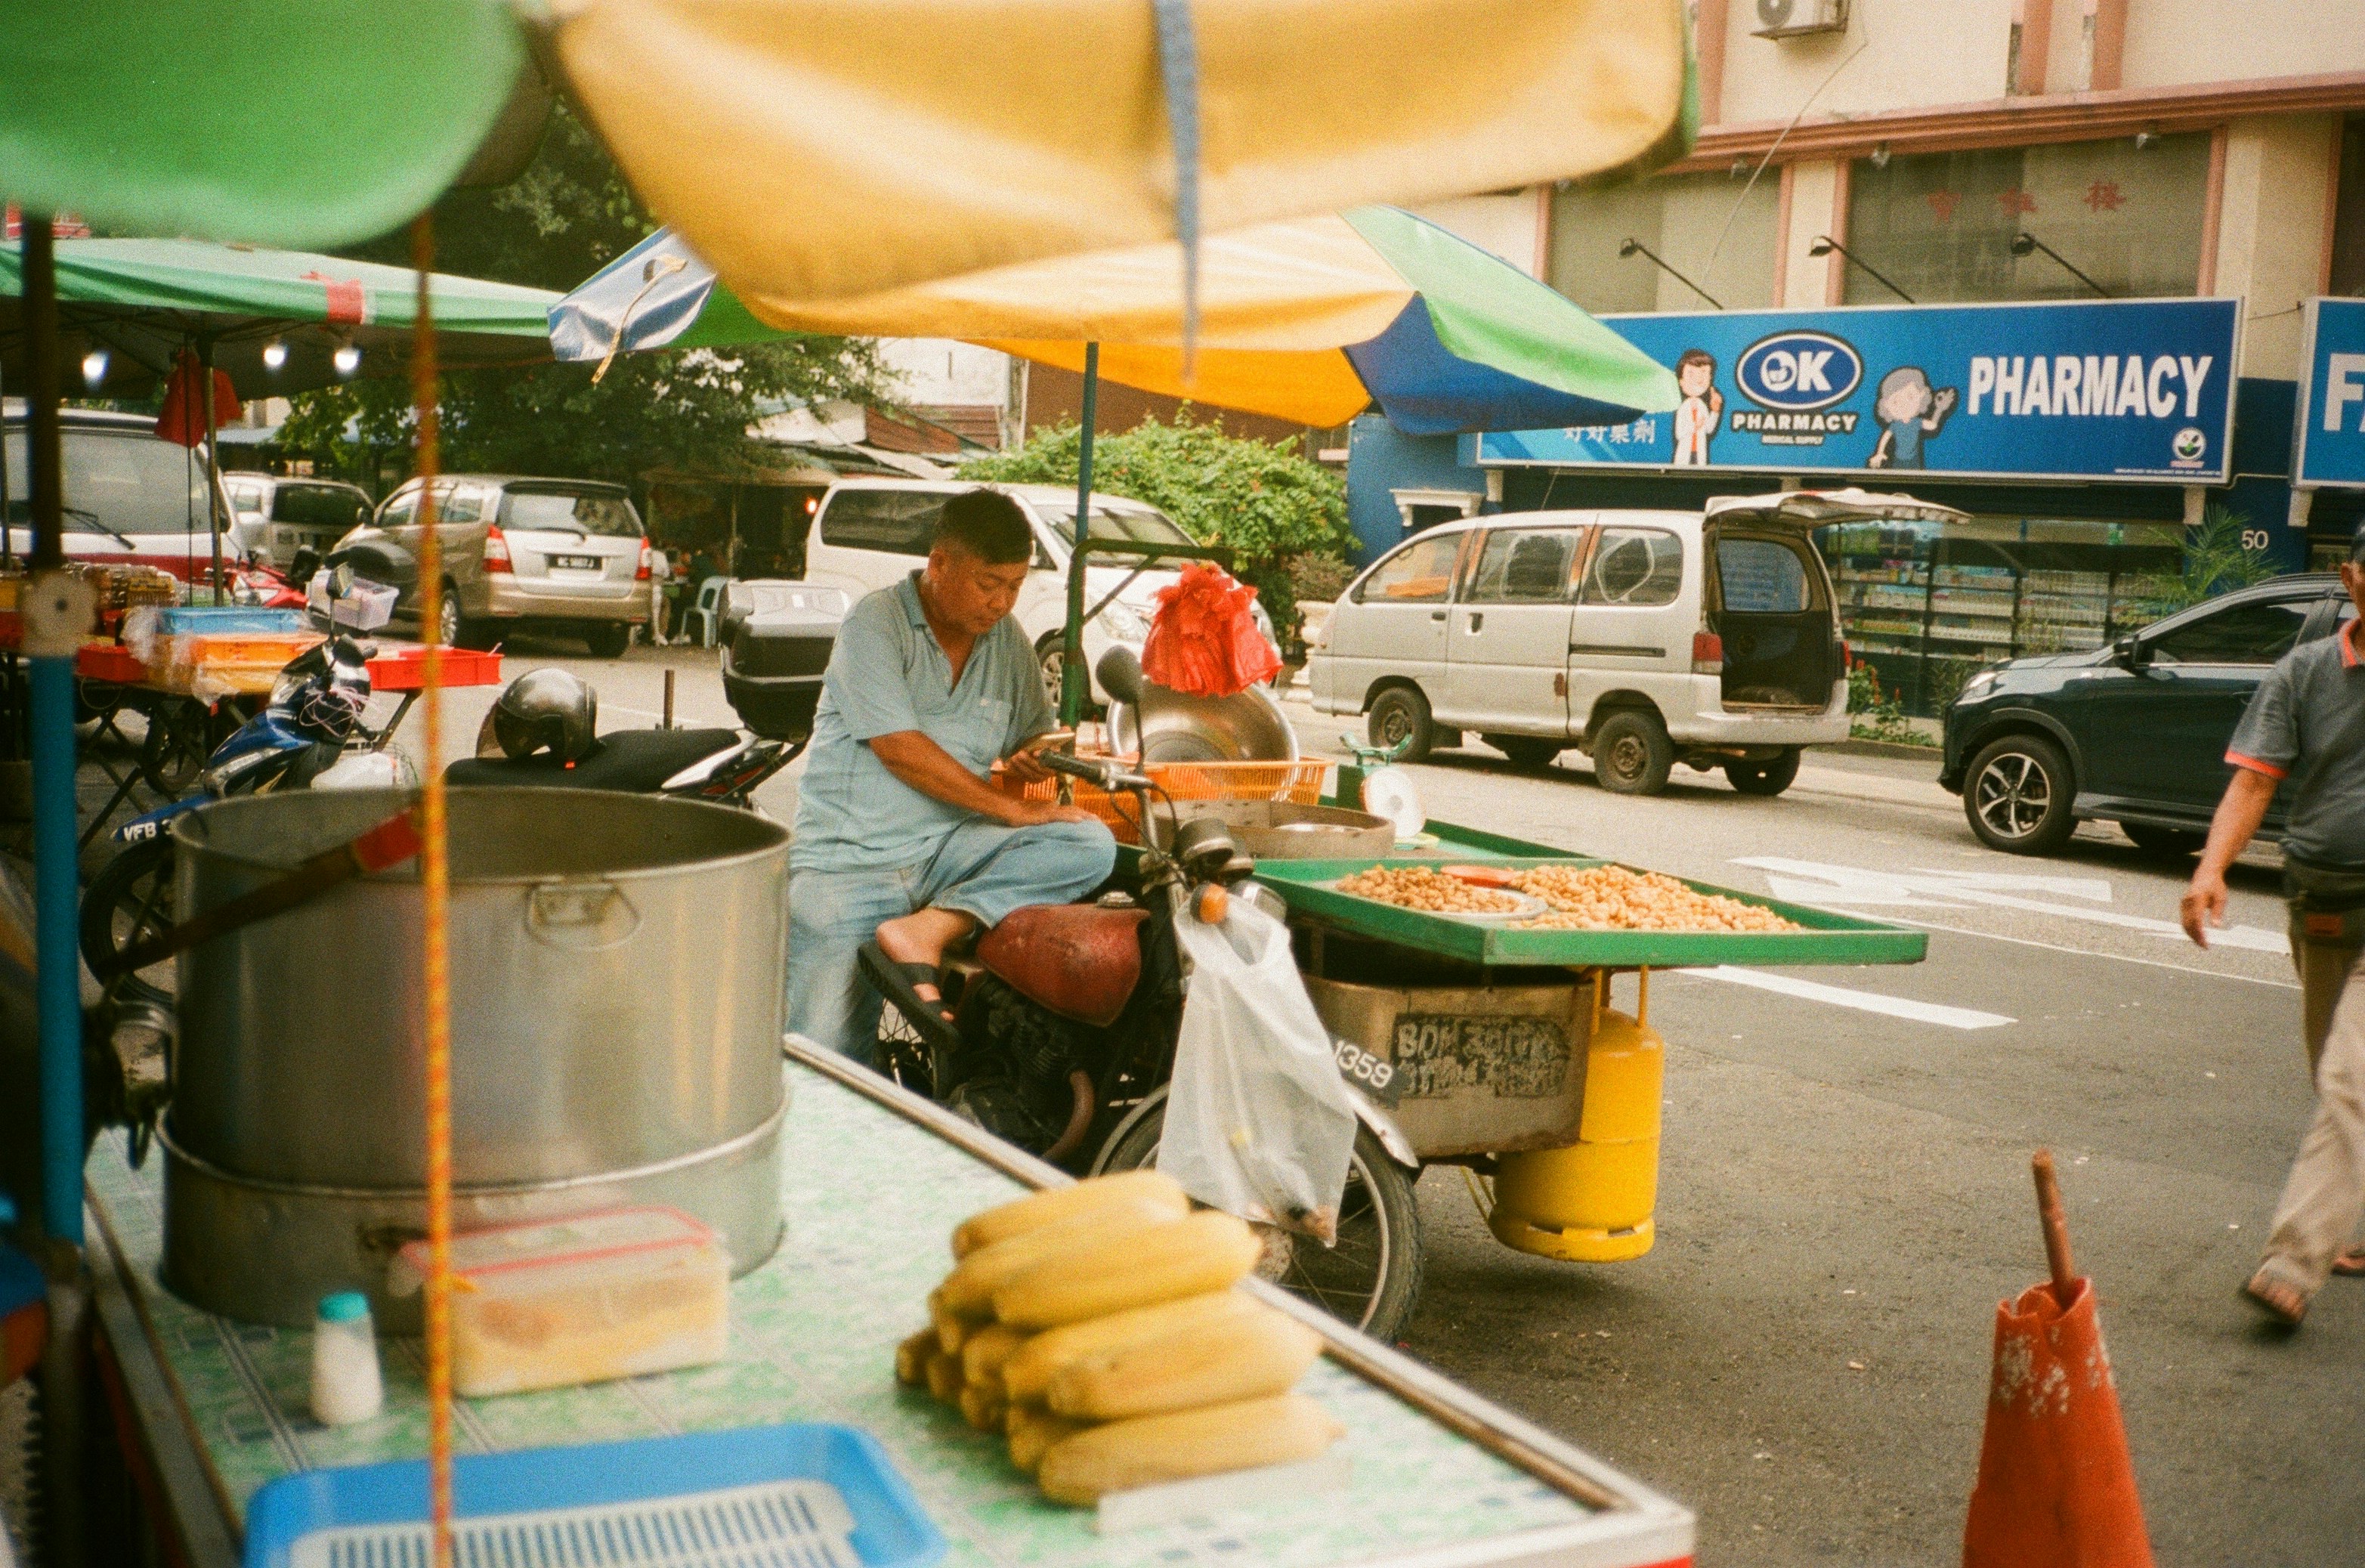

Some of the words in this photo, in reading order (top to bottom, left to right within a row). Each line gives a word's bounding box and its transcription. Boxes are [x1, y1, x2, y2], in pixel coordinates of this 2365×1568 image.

[1761, 350, 1835, 392] OK
[1968, 354, 2213, 418] PHARMACY
[2323, 353, 2365, 432] F
[1733, 413, 1857, 431] PHARMACY
[2241, 530, 2268, 549] 50
[123, 821, 157, 841] VFB
